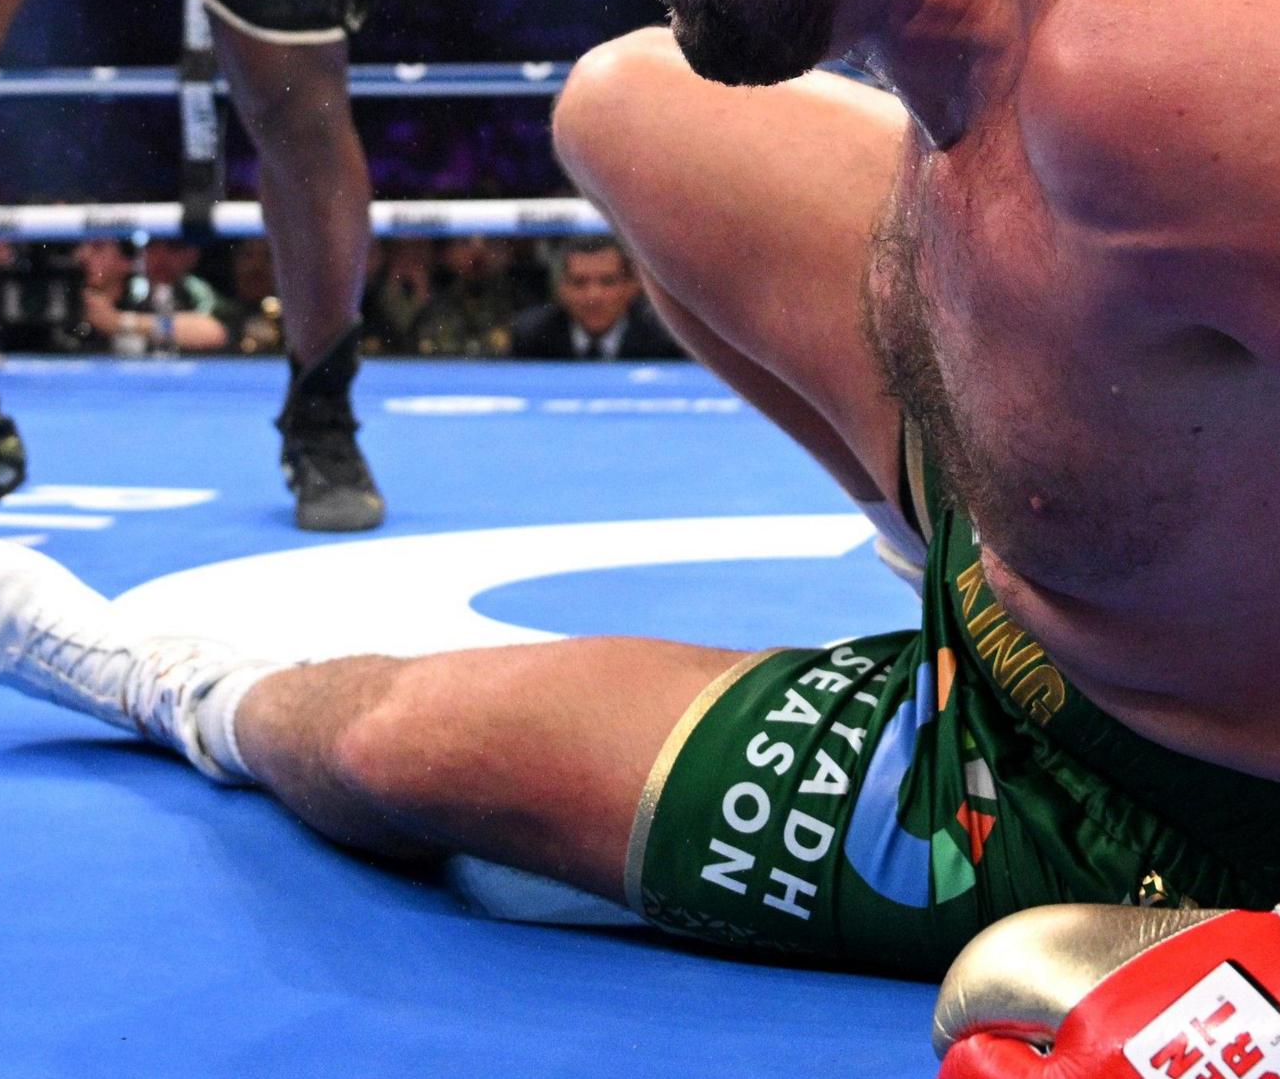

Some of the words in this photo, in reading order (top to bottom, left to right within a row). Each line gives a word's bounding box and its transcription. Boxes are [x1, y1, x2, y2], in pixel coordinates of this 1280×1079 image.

[955, 560, 1067, 727] KING
[699, 645, 876, 896] SEASON
[762, 665, 894, 921] IYADH
